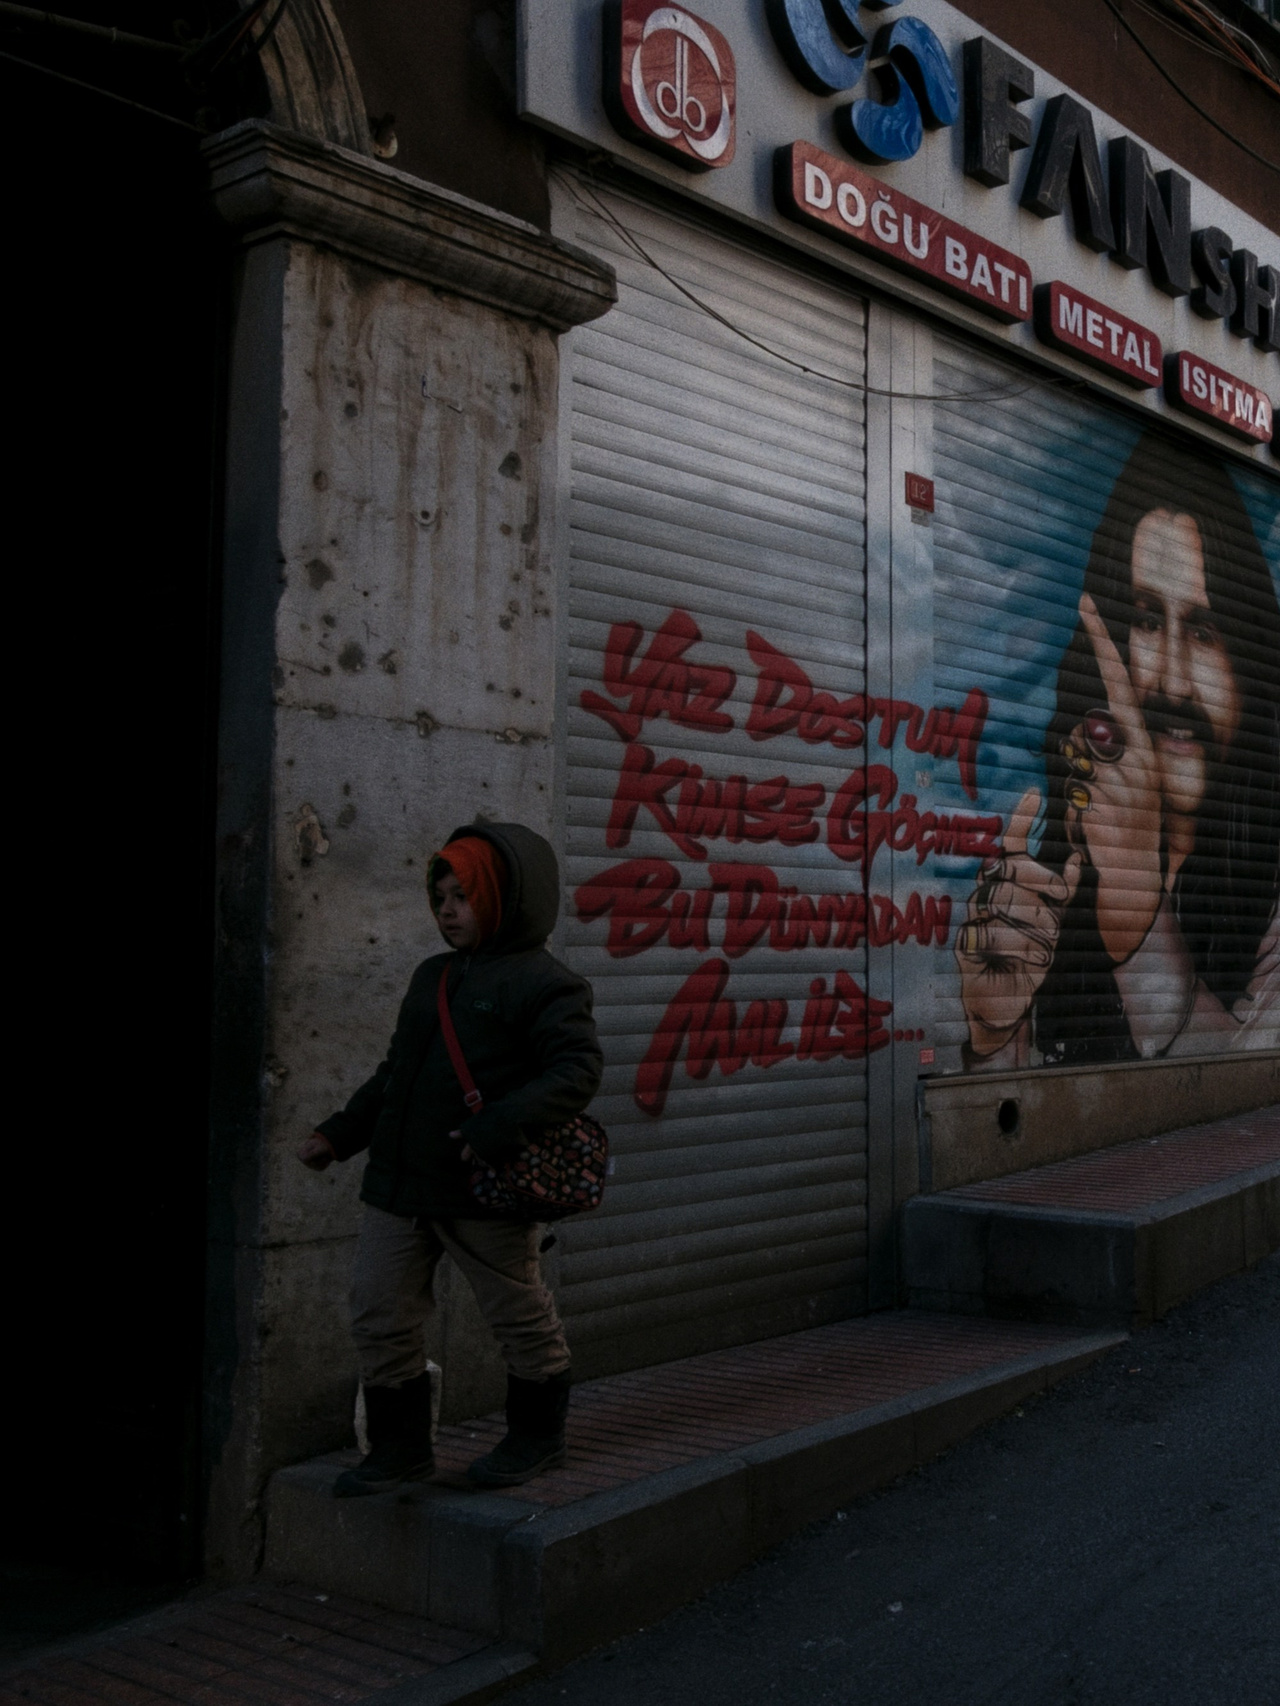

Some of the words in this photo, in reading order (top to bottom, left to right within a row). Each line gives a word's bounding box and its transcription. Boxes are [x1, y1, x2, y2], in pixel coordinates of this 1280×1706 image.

[804, 161, 930, 261] DOĞU
[944, 235, 1030, 313] BATI
[1058, 296, 1160, 378] METAL
[1182, 359, 1272, 435] ISITMA
[580, 607, 737, 743] YAZ
[745, 629, 990, 801] DOSTUM
[826, 764, 1004, 870] GÖÇMEZ
[574, 858, 712, 959] BU
[709, 863, 952, 959] DÜNYADAN
[634, 958, 794, 1117] MAL
